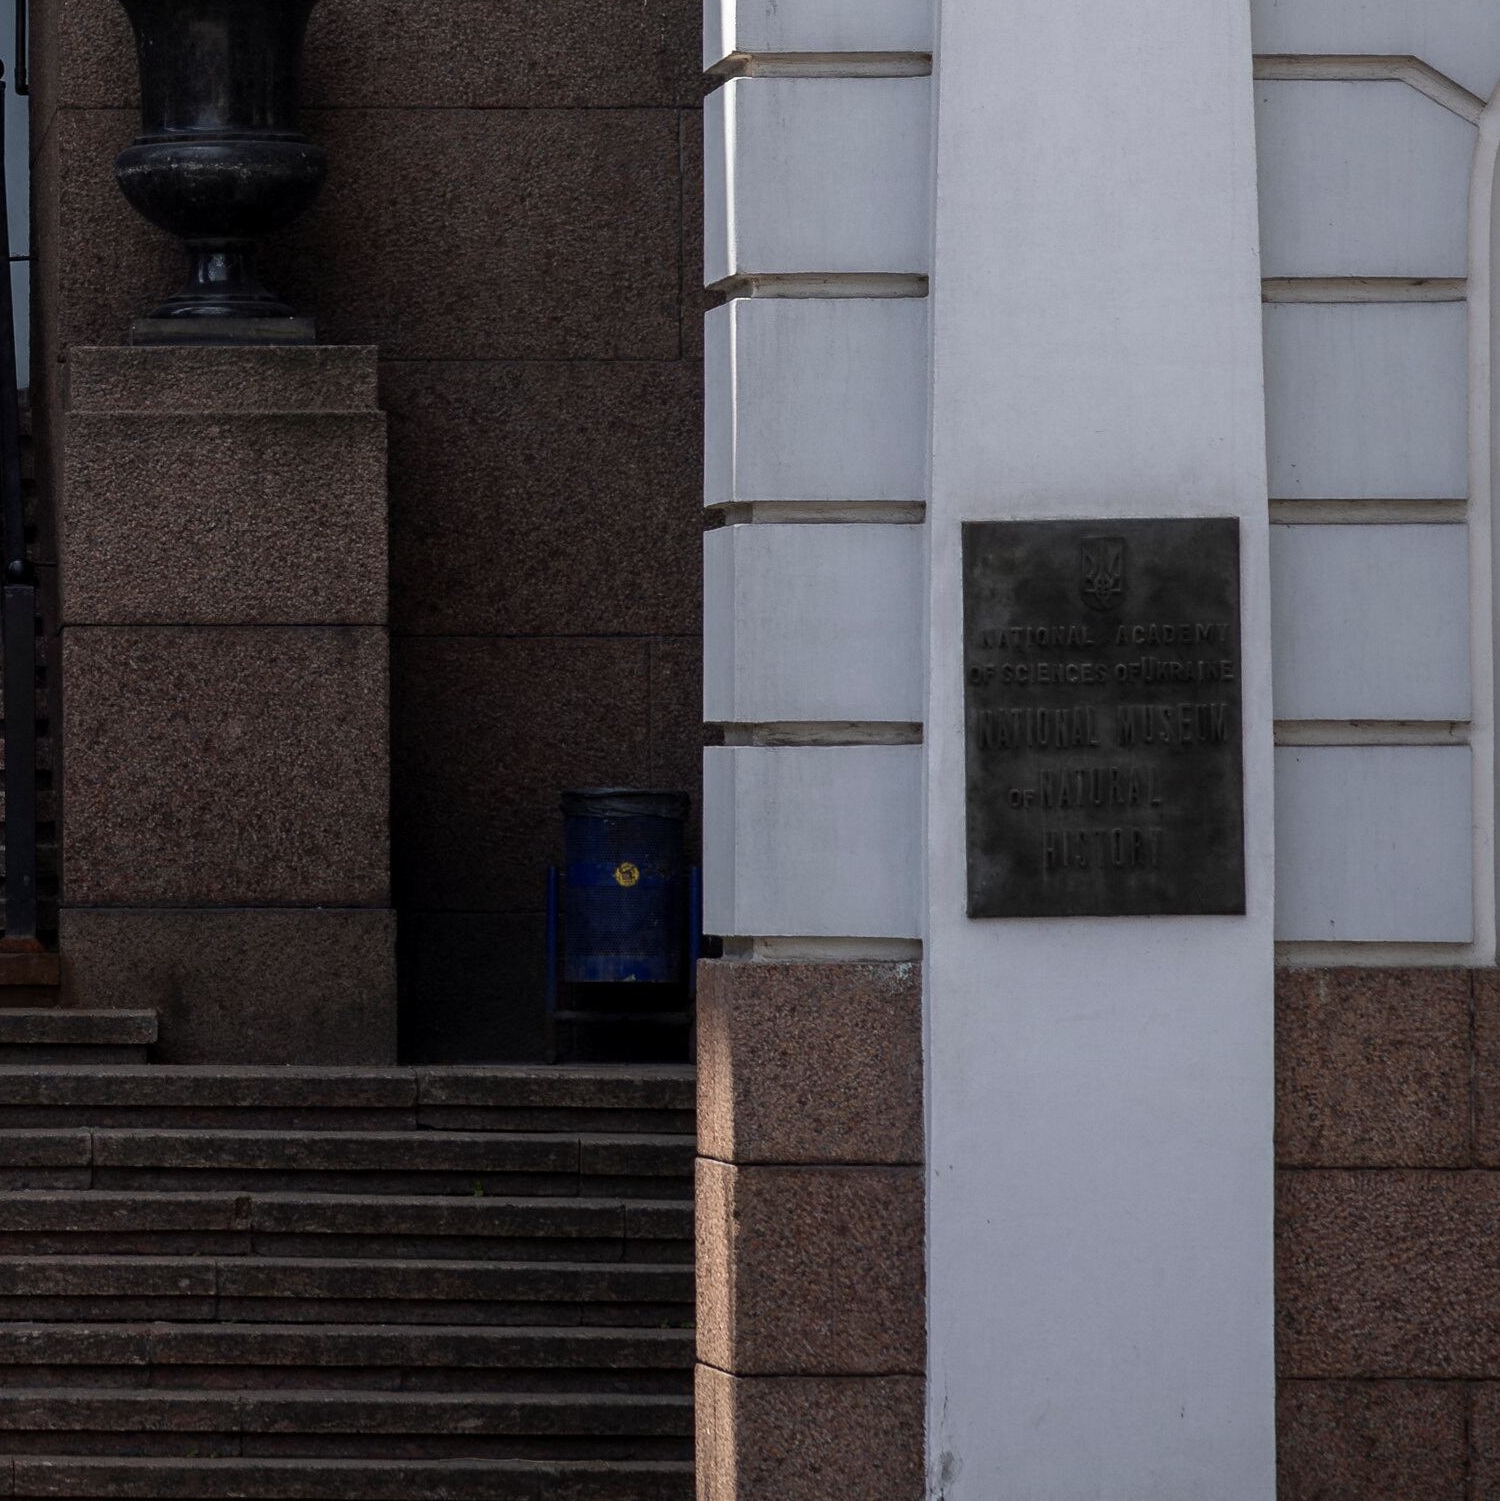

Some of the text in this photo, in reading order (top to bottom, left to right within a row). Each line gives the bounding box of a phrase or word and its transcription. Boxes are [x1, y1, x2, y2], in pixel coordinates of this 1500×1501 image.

[979, 621, 1231, 649] NATIONAL ACADEMY
[969, 656, 1236, 687] OF SCIENCES OF UKRAINE
[977, 702, 1230, 749] NATIONAL MUSEUM
[1007, 766, 1164, 810] OF NATURAL
[1042, 827, 1164, 870] HISTORY
